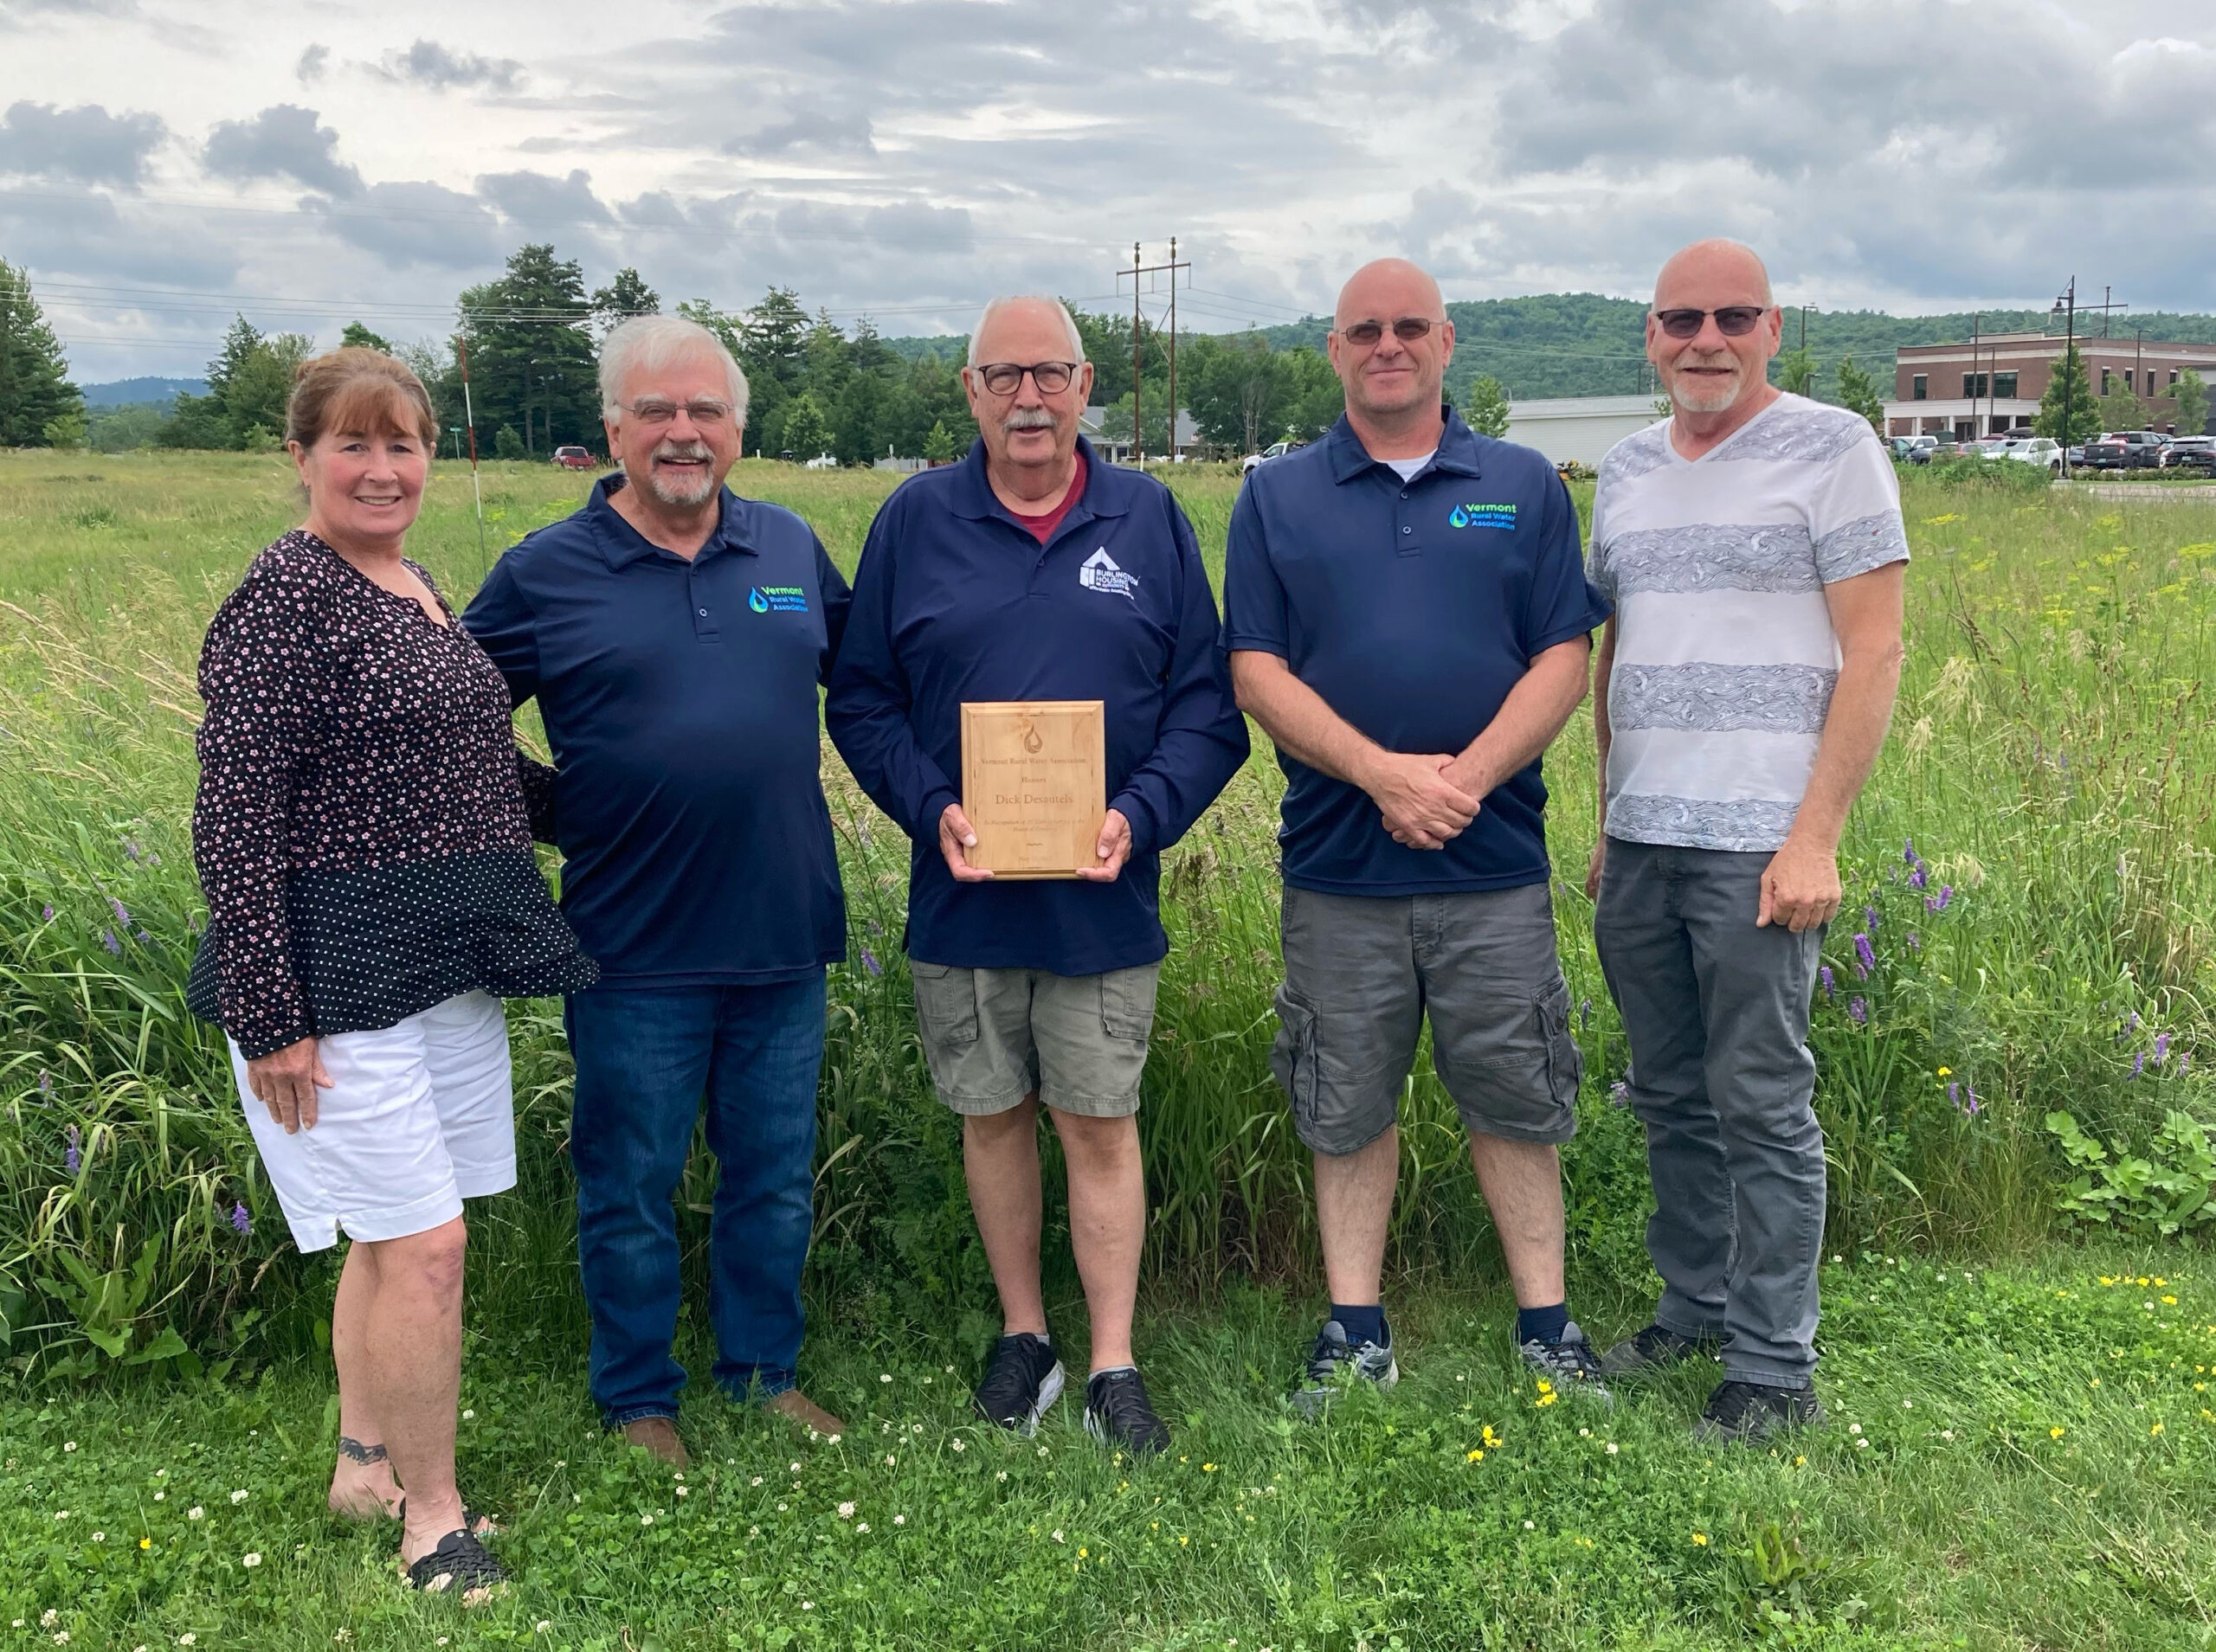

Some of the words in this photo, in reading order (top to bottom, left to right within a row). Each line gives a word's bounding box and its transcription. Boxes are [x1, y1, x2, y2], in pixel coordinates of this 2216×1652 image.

[1466, 504, 1517, 513] Vermont
[1493, 513, 1516, 522] Water
[1472, 520, 1516, 530] Association
[1096, 569, 1139, 587] BURLINGTON
[1096, 575, 1129, 588] HOUSING
[761, 587, 804, 596] Vermont
[995, 794, 1021, 805] Dick
[1024, 794, 1073, 804] Desautels
